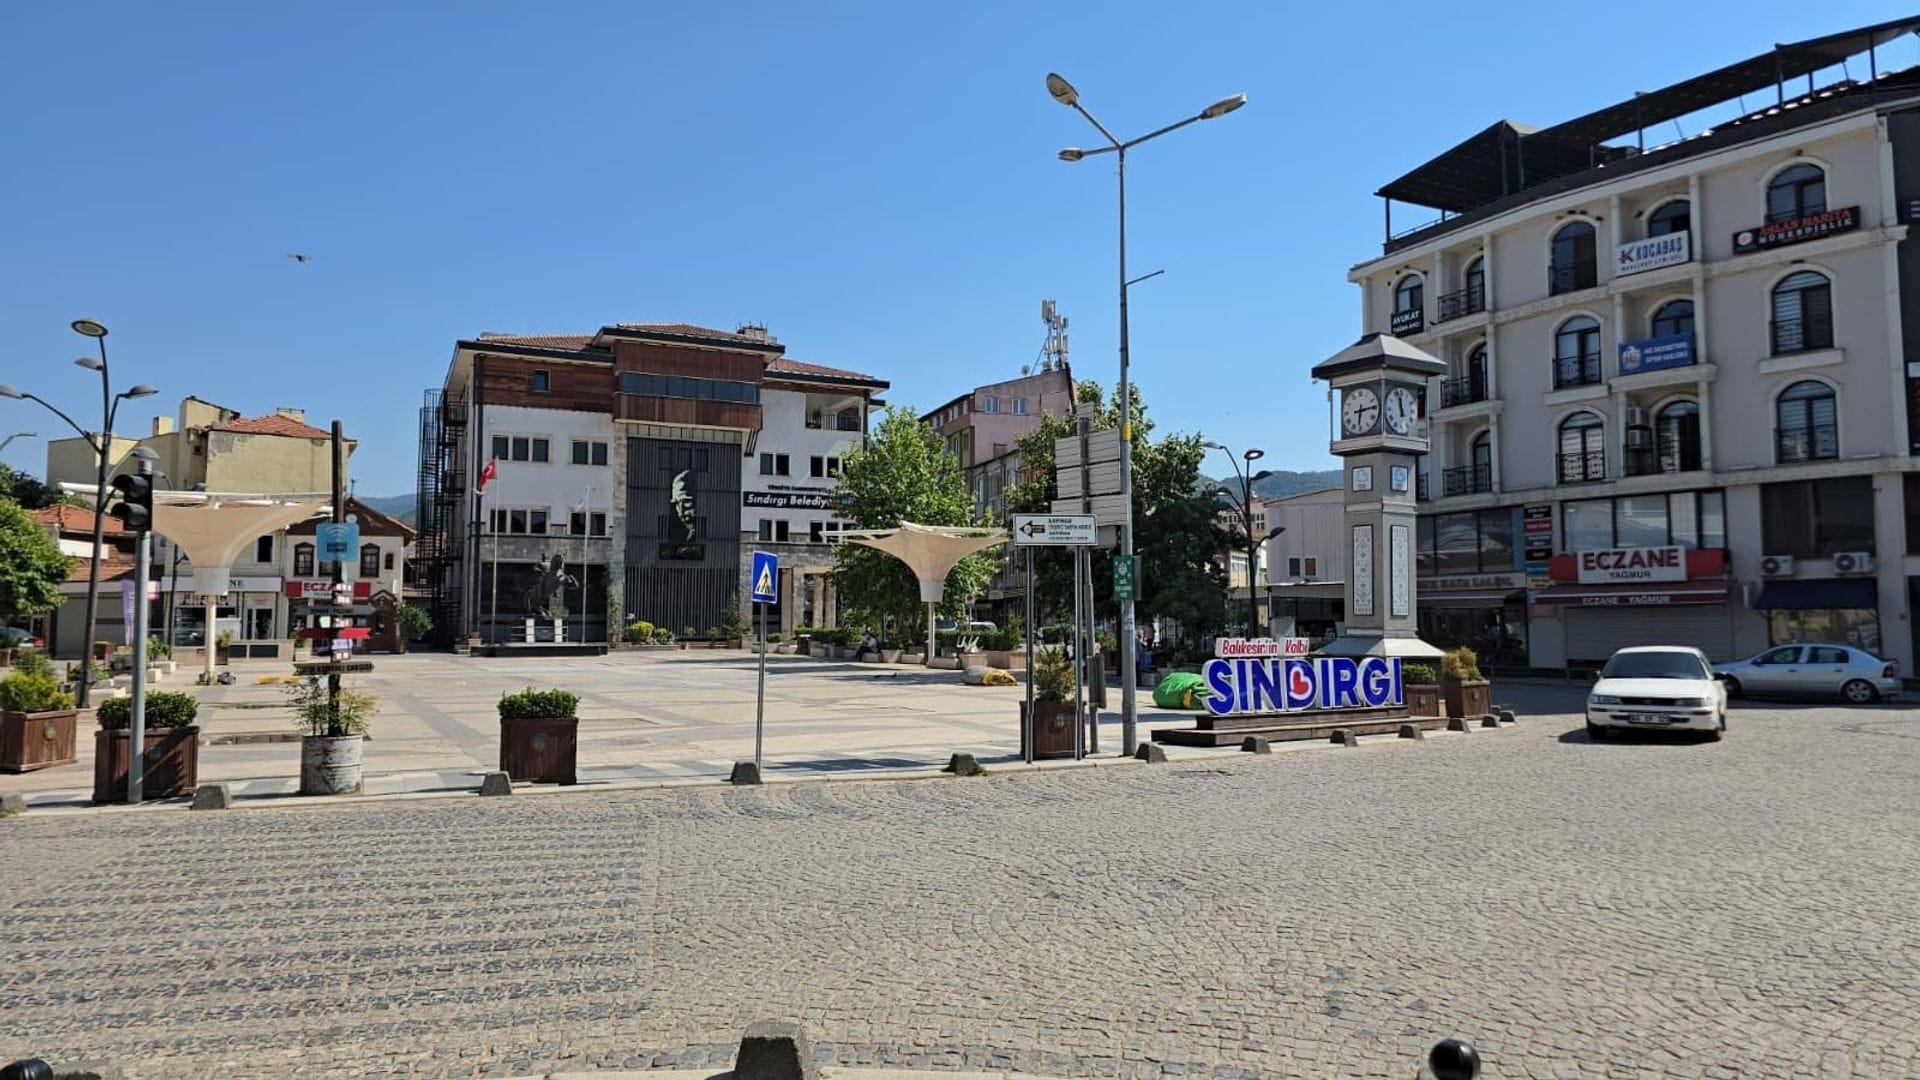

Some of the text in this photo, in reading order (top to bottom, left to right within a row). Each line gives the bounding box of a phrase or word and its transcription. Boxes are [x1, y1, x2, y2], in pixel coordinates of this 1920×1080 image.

[1583, 549, 1680, 571] ECZANE
[1582, 597, 1619, 605] ECZANE
[1206, 657, 1403, 717] SINDIRGI
